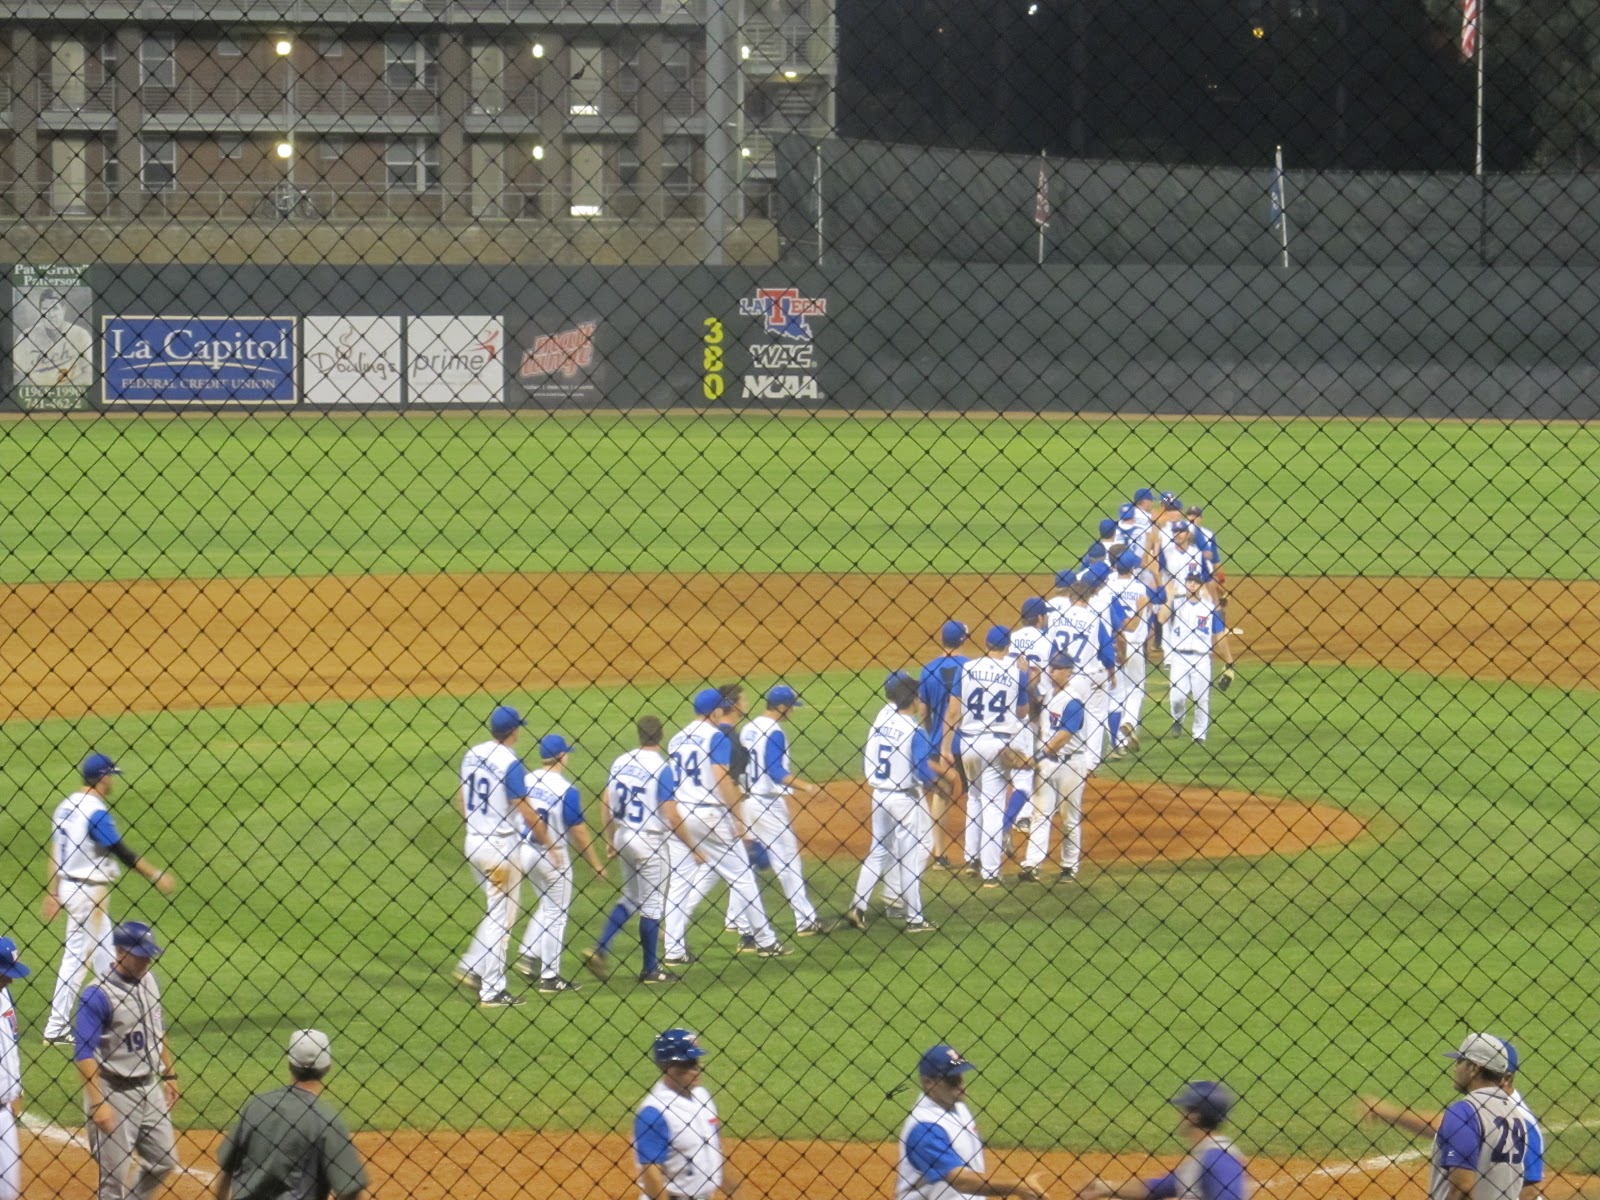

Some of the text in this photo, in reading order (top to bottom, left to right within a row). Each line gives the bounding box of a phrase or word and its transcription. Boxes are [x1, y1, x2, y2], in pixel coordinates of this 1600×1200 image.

[111, 328, 288, 370] La Capitol
[413, 348, 484, 378] prime
[750, 345, 813, 368] WAC
[122, 378, 276, 389] FEDERAL CREDIT UNION
[742, 375, 818, 399] NCAA
[1055, 630, 1089, 663] 37
[968, 671, 1013, 688] WILLIAMS
[967, 687, 1008, 722] 44
[874, 744, 892, 779] 5
[468, 772, 490, 815] 19
[614, 781, 646, 823] 35
[124, 1031, 144, 1052] 19
[1490, 1116, 1526, 1164] 29
